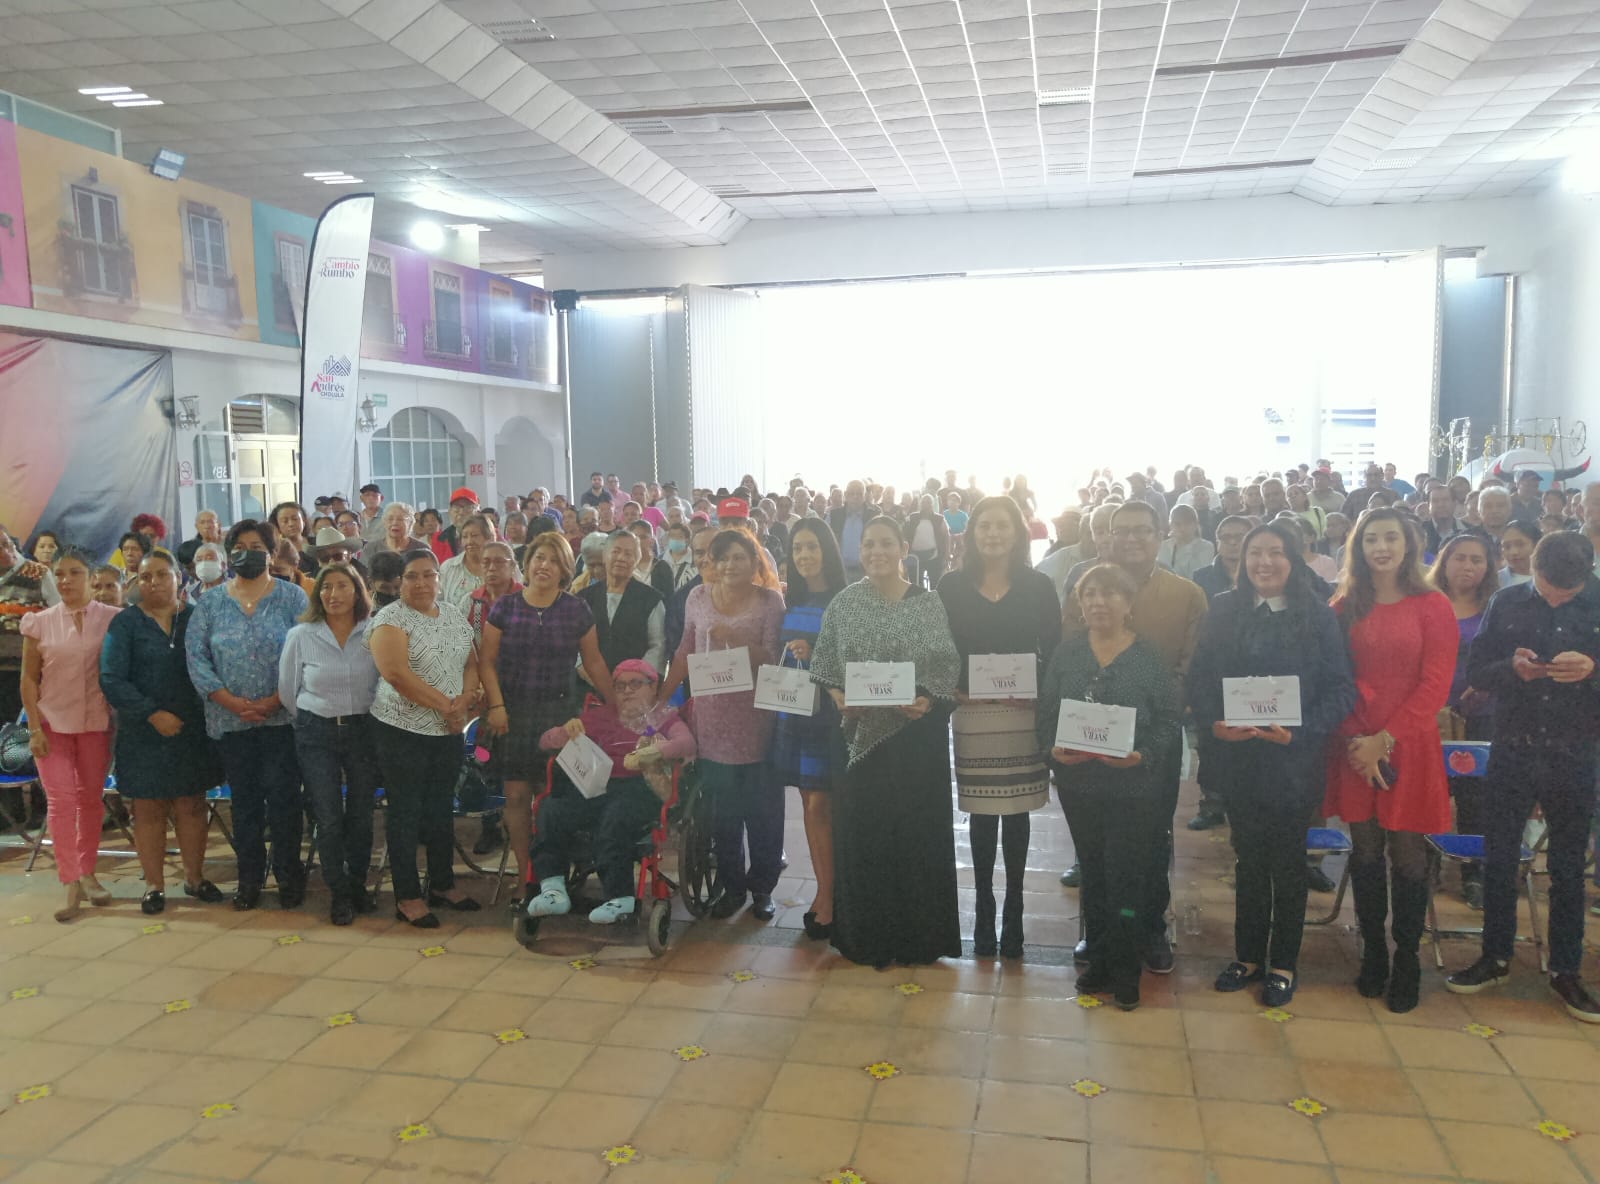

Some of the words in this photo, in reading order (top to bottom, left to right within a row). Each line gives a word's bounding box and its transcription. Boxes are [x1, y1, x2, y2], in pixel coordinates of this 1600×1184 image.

[324, 259, 360, 270] Cambio
[319, 267, 355, 278] Rumbo
[317, 373, 334, 383] San
[310, 381, 345, 392] Andrés
